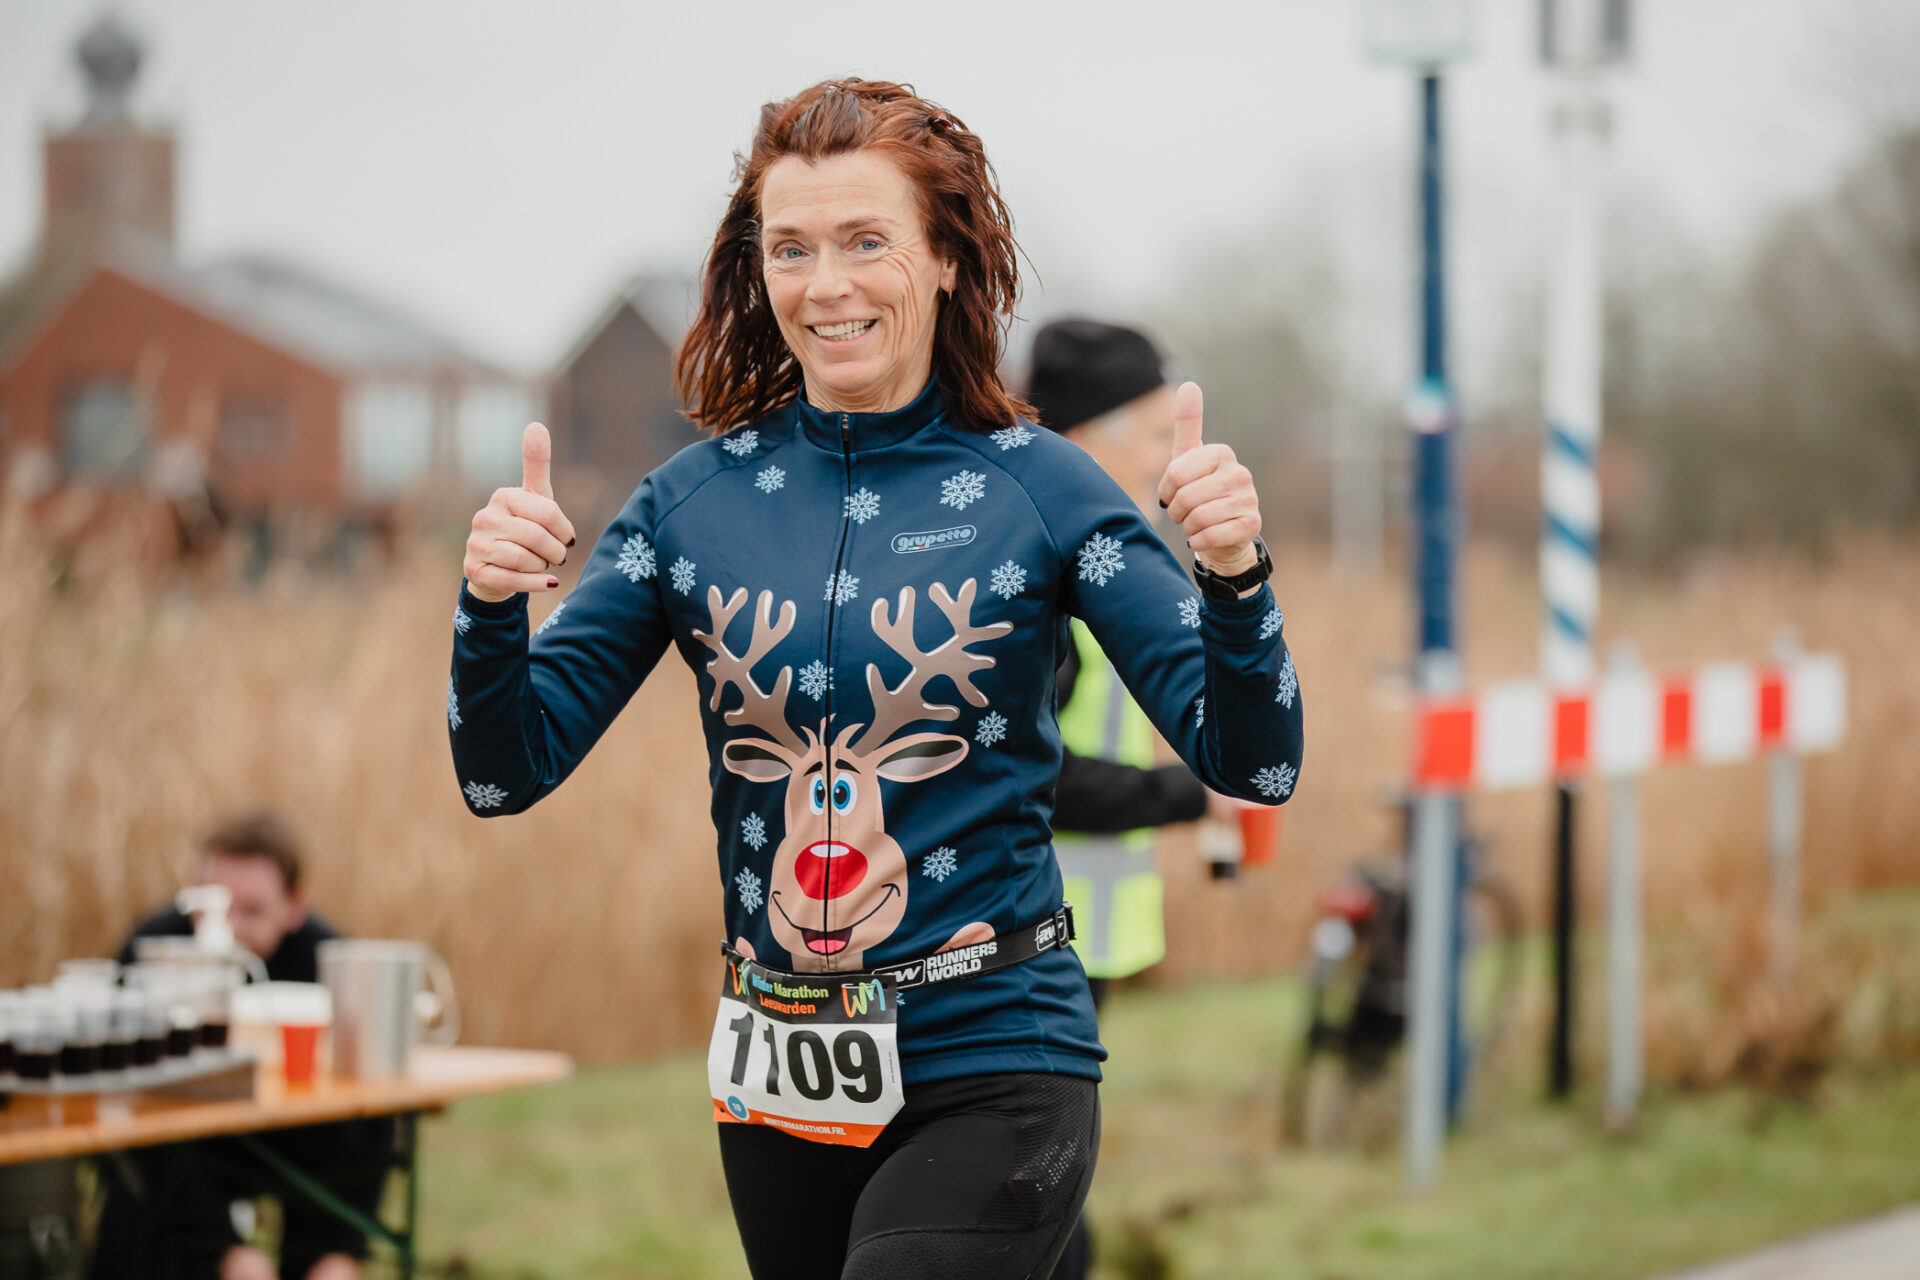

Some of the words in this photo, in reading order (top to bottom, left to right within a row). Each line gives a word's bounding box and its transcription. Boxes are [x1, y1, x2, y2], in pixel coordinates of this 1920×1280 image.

[897, 528, 971, 552] grupetto
[926, 942, 998, 969] RUNNERS
[926, 959, 982, 982] WORLD
[773, 982, 829, 999] Marathon
[759, 993, 817, 1015] Leeuwarden
[729, 1011, 883, 1104] 1109
[762, 1116, 847, 1136] WINTERMARATHON.FRL
